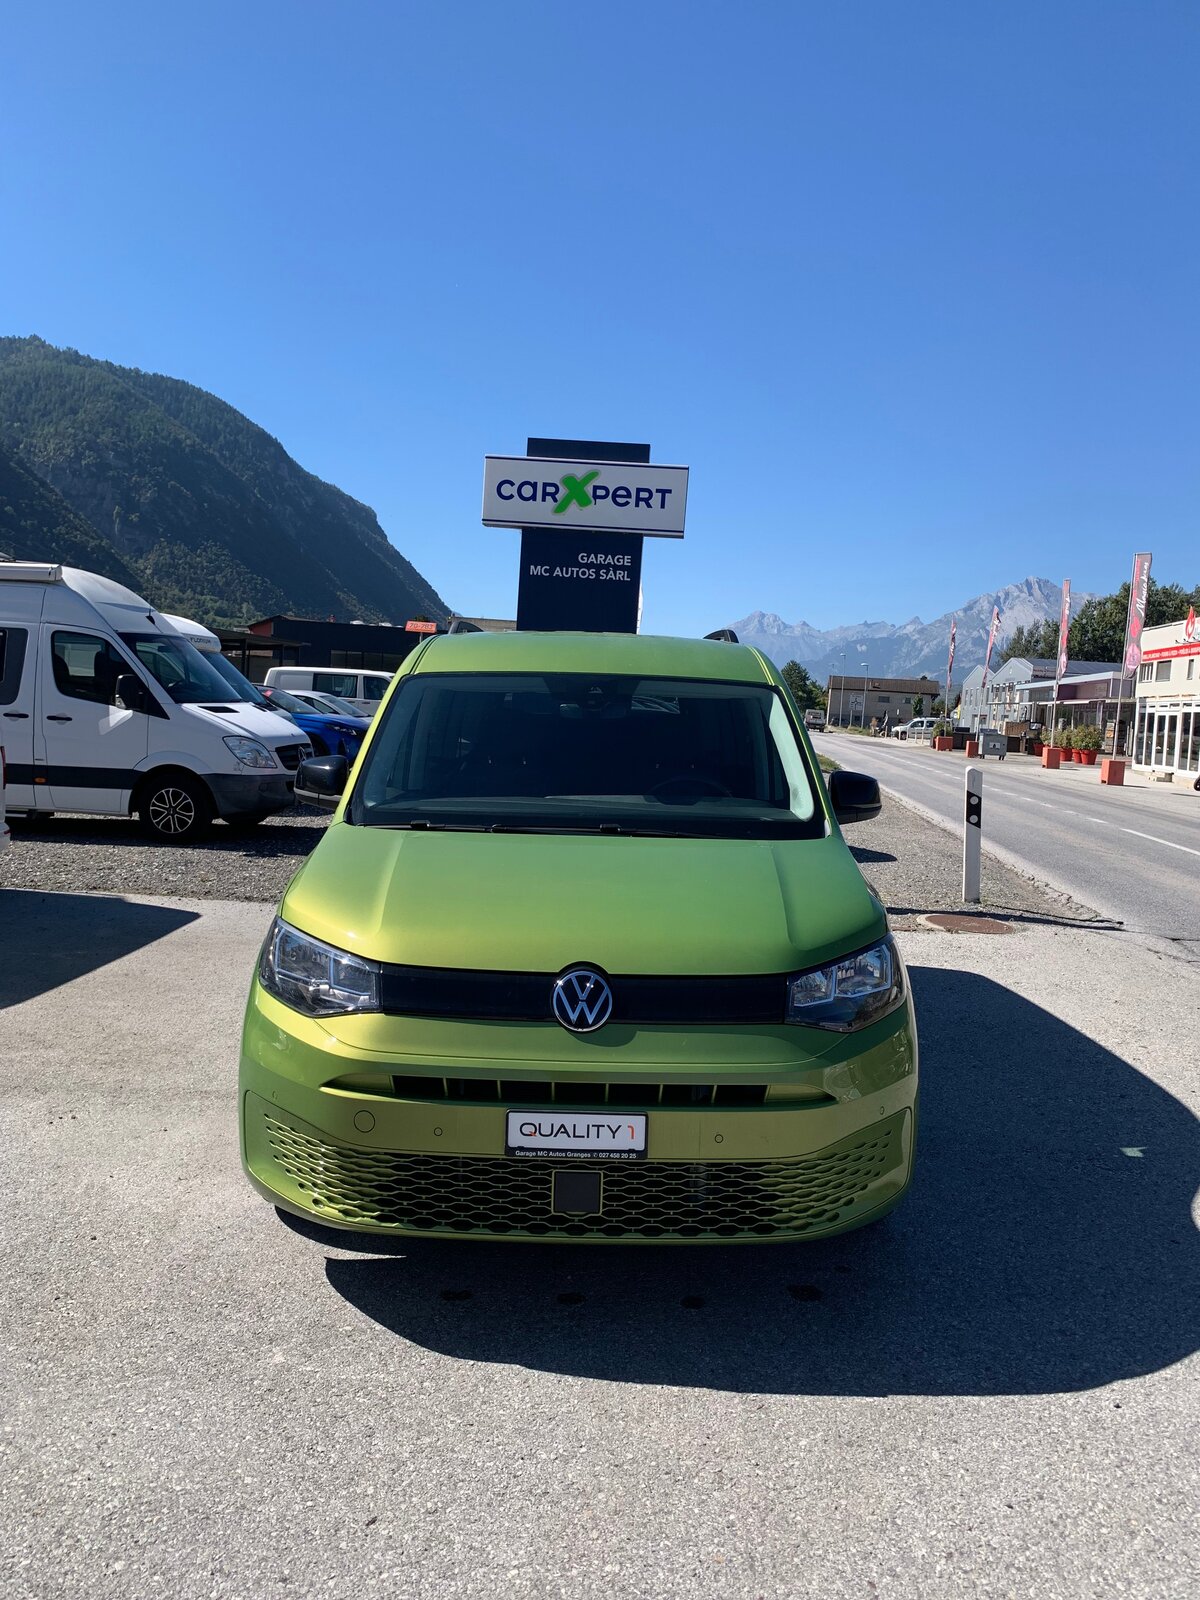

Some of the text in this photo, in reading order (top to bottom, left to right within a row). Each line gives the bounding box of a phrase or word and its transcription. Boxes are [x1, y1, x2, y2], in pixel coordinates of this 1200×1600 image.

[578, 553, 632, 566] GARAGE
[529, 565, 631, 581] MC AUTOS SÀRL
[556, 974, 610, 1026] VW
[519, 1122, 622, 1139] QUALITY
[515, 1150, 537, 1158] Garage
